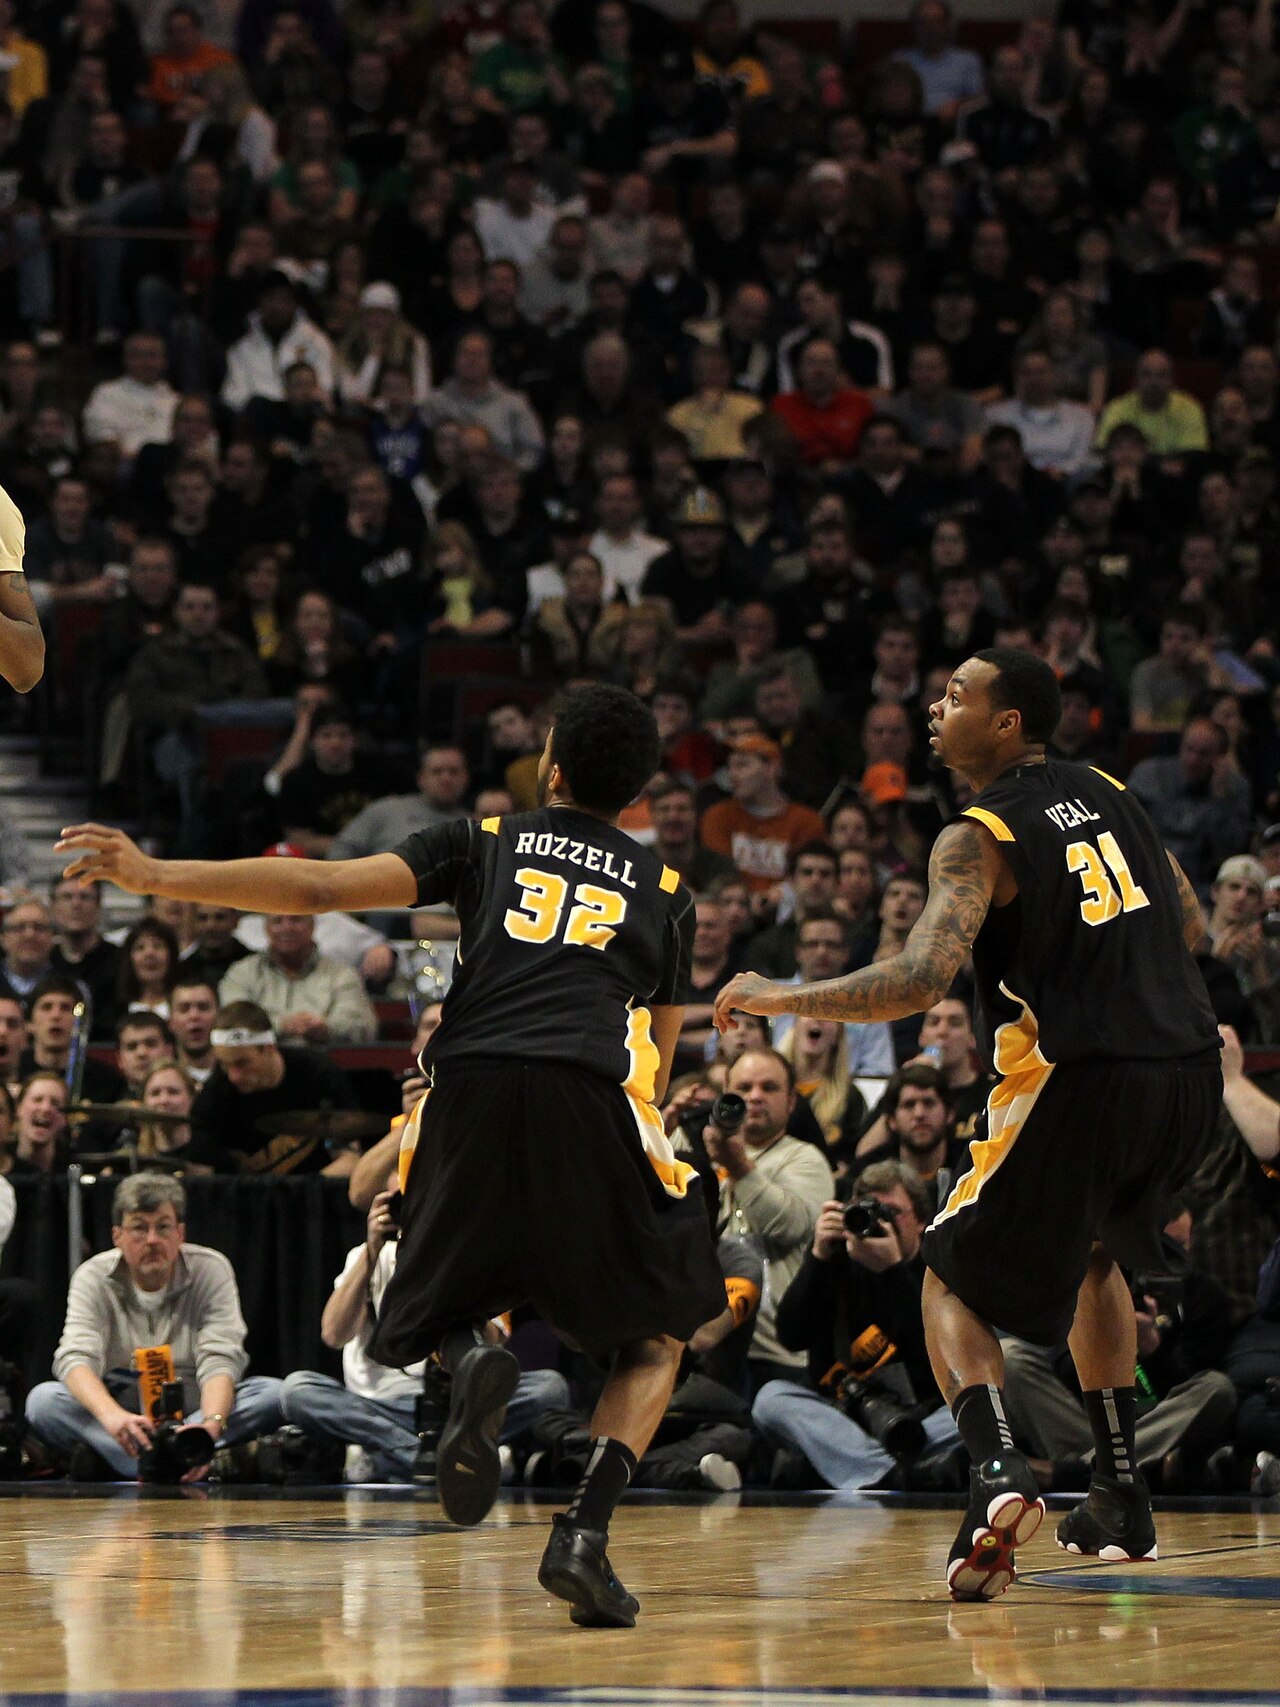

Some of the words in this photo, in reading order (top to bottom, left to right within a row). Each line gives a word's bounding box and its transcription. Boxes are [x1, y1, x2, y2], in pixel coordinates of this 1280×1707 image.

[1043, 798, 1101, 832] VEAL
[514, 831, 637, 889] ROZZELL
[1065, 830, 1151, 926] 31
[503, 867, 627, 951] 32
